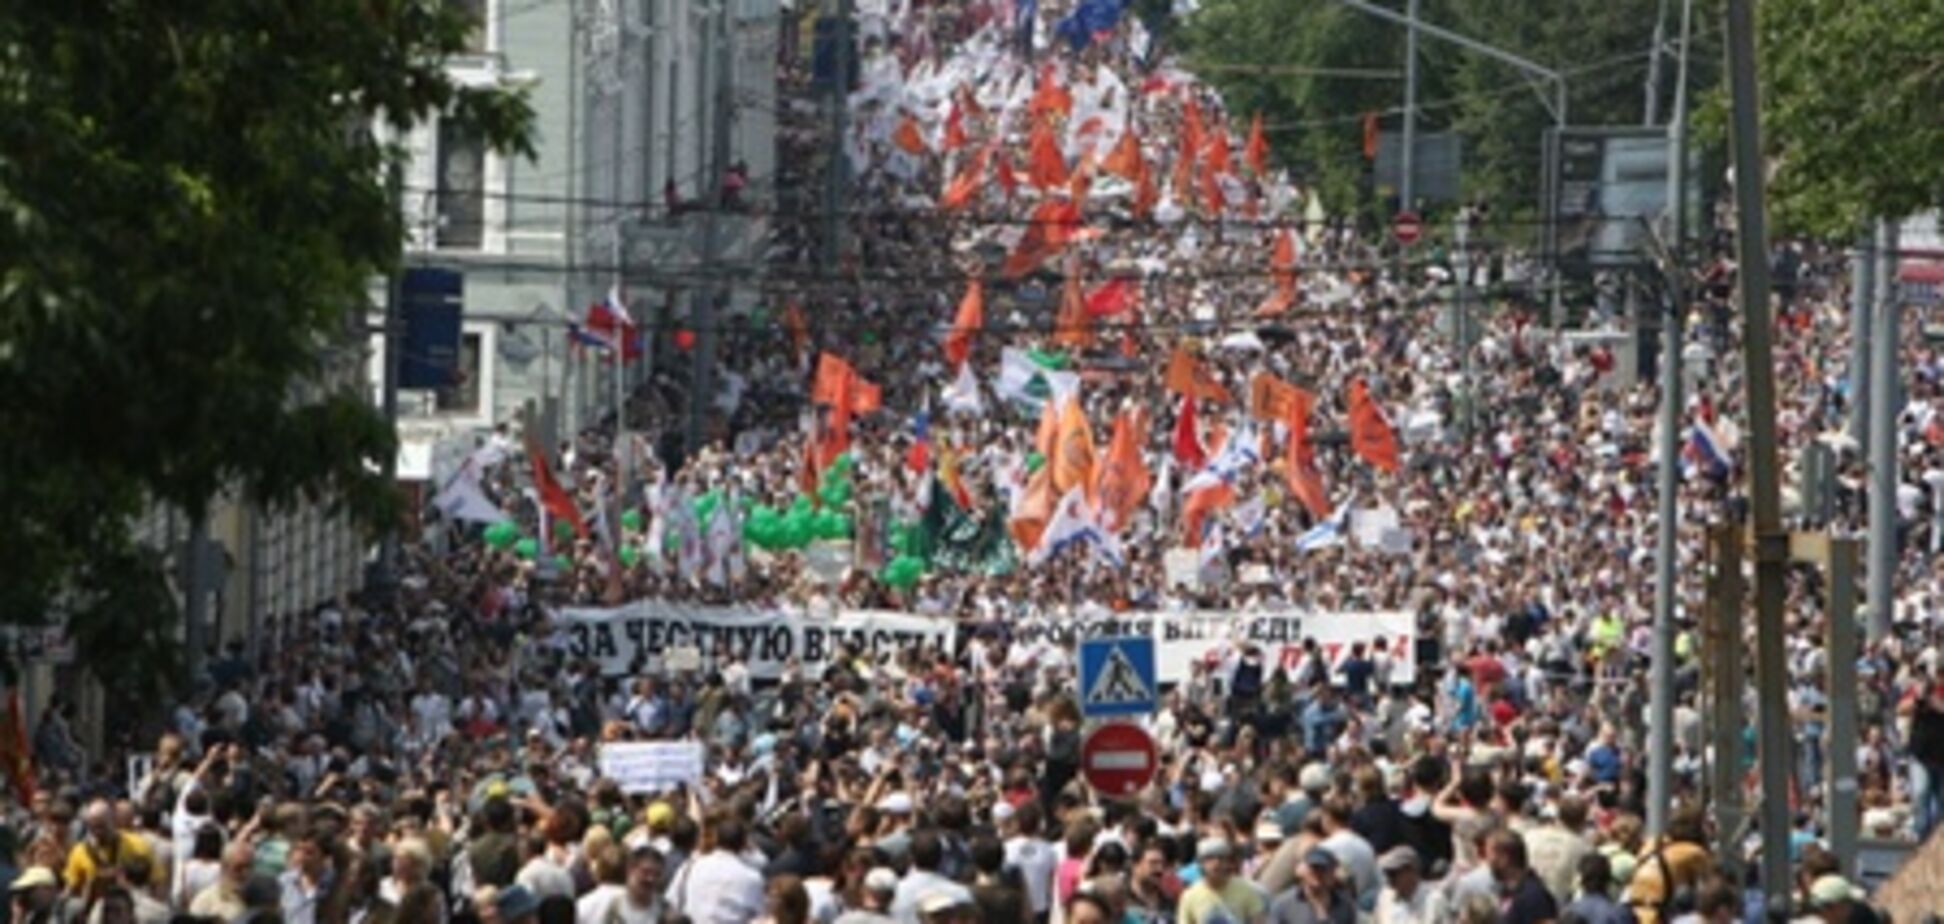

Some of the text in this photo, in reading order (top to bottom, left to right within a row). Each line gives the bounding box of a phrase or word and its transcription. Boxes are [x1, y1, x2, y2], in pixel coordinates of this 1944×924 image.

[569, 621, 618, 658] ЗА
[626, 618, 793, 663] ЧЕСТНУЮ
[1163, 617, 1302, 644] ВПЕД!
